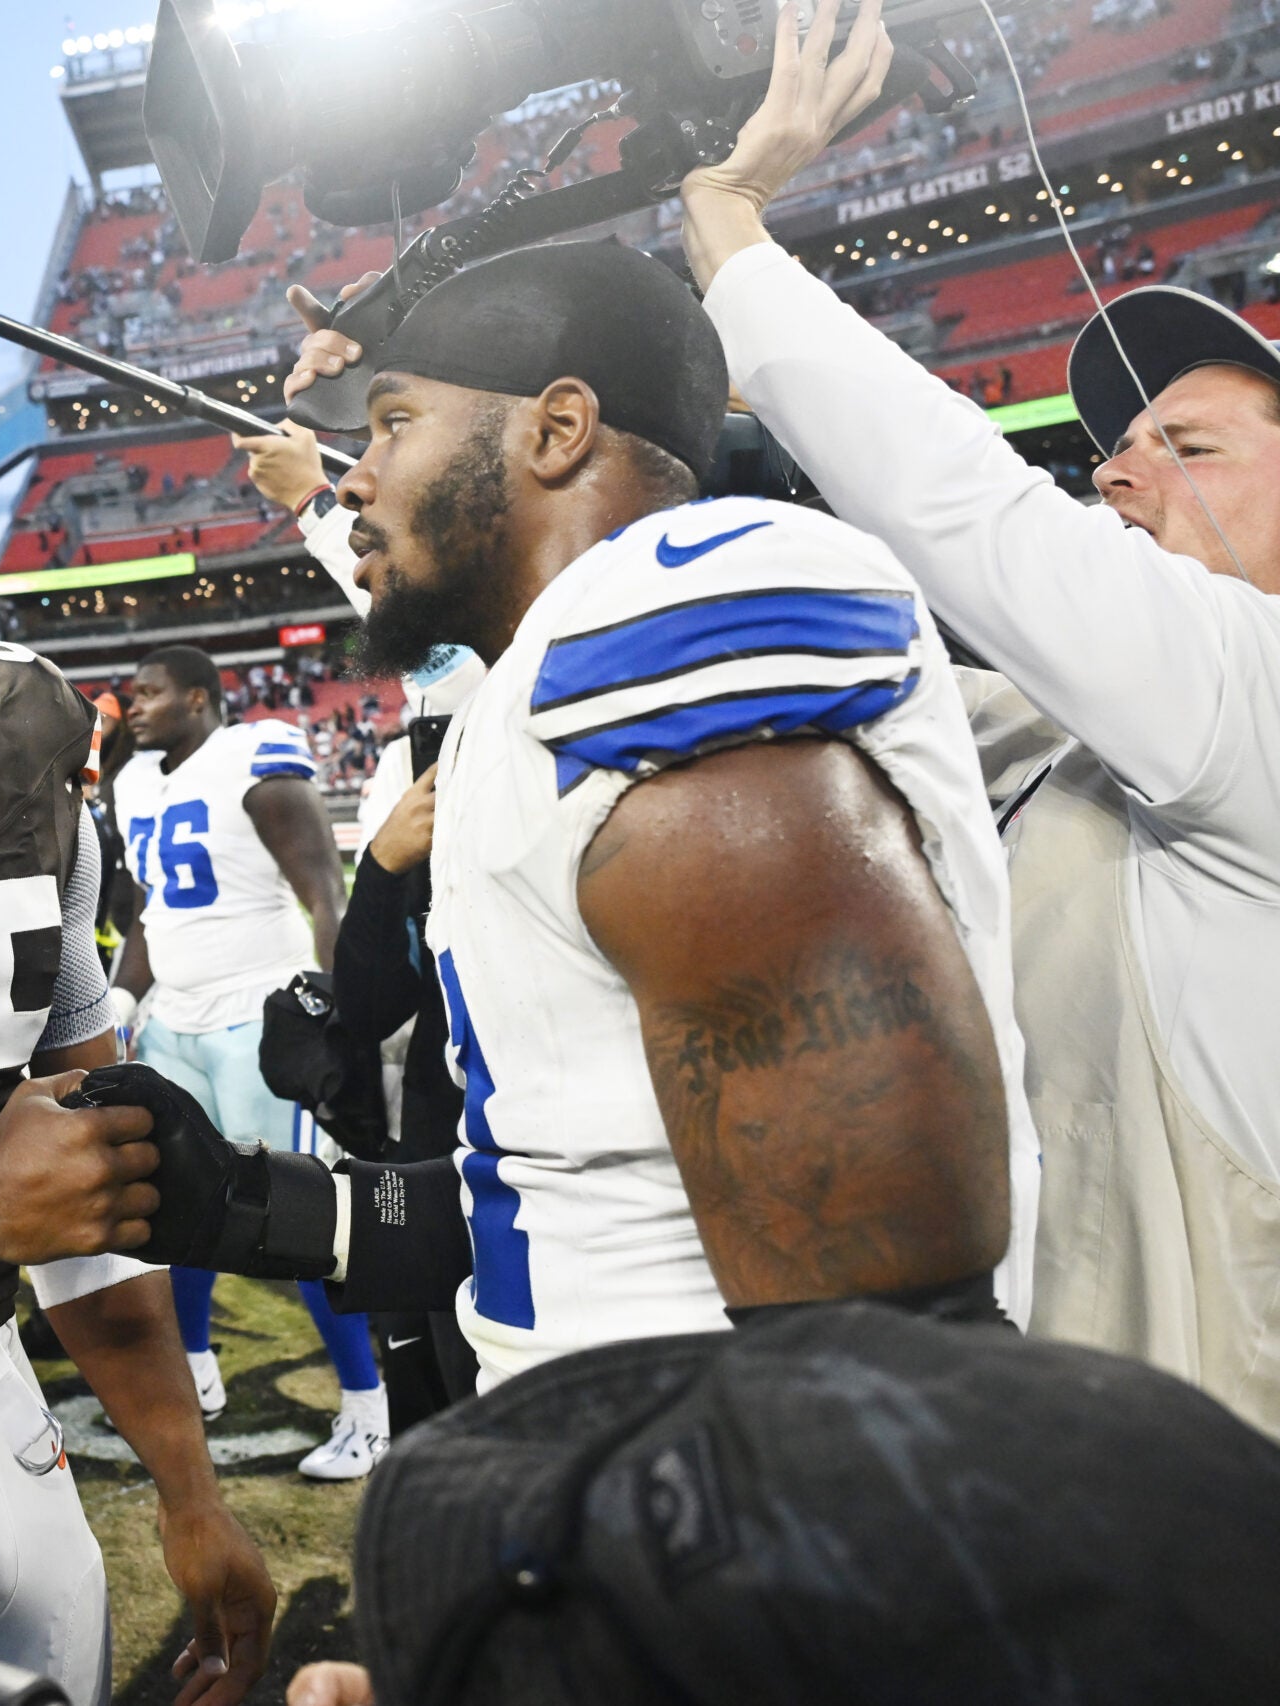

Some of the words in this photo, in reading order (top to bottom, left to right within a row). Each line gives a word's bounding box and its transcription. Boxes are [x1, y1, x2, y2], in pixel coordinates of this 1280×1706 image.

[1166, 97, 1246, 134] LEROY
[837, 181, 907, 223] FRANK
[129, 799, 219, 909] 76
[398, 1188, 406, 1198] Dry
